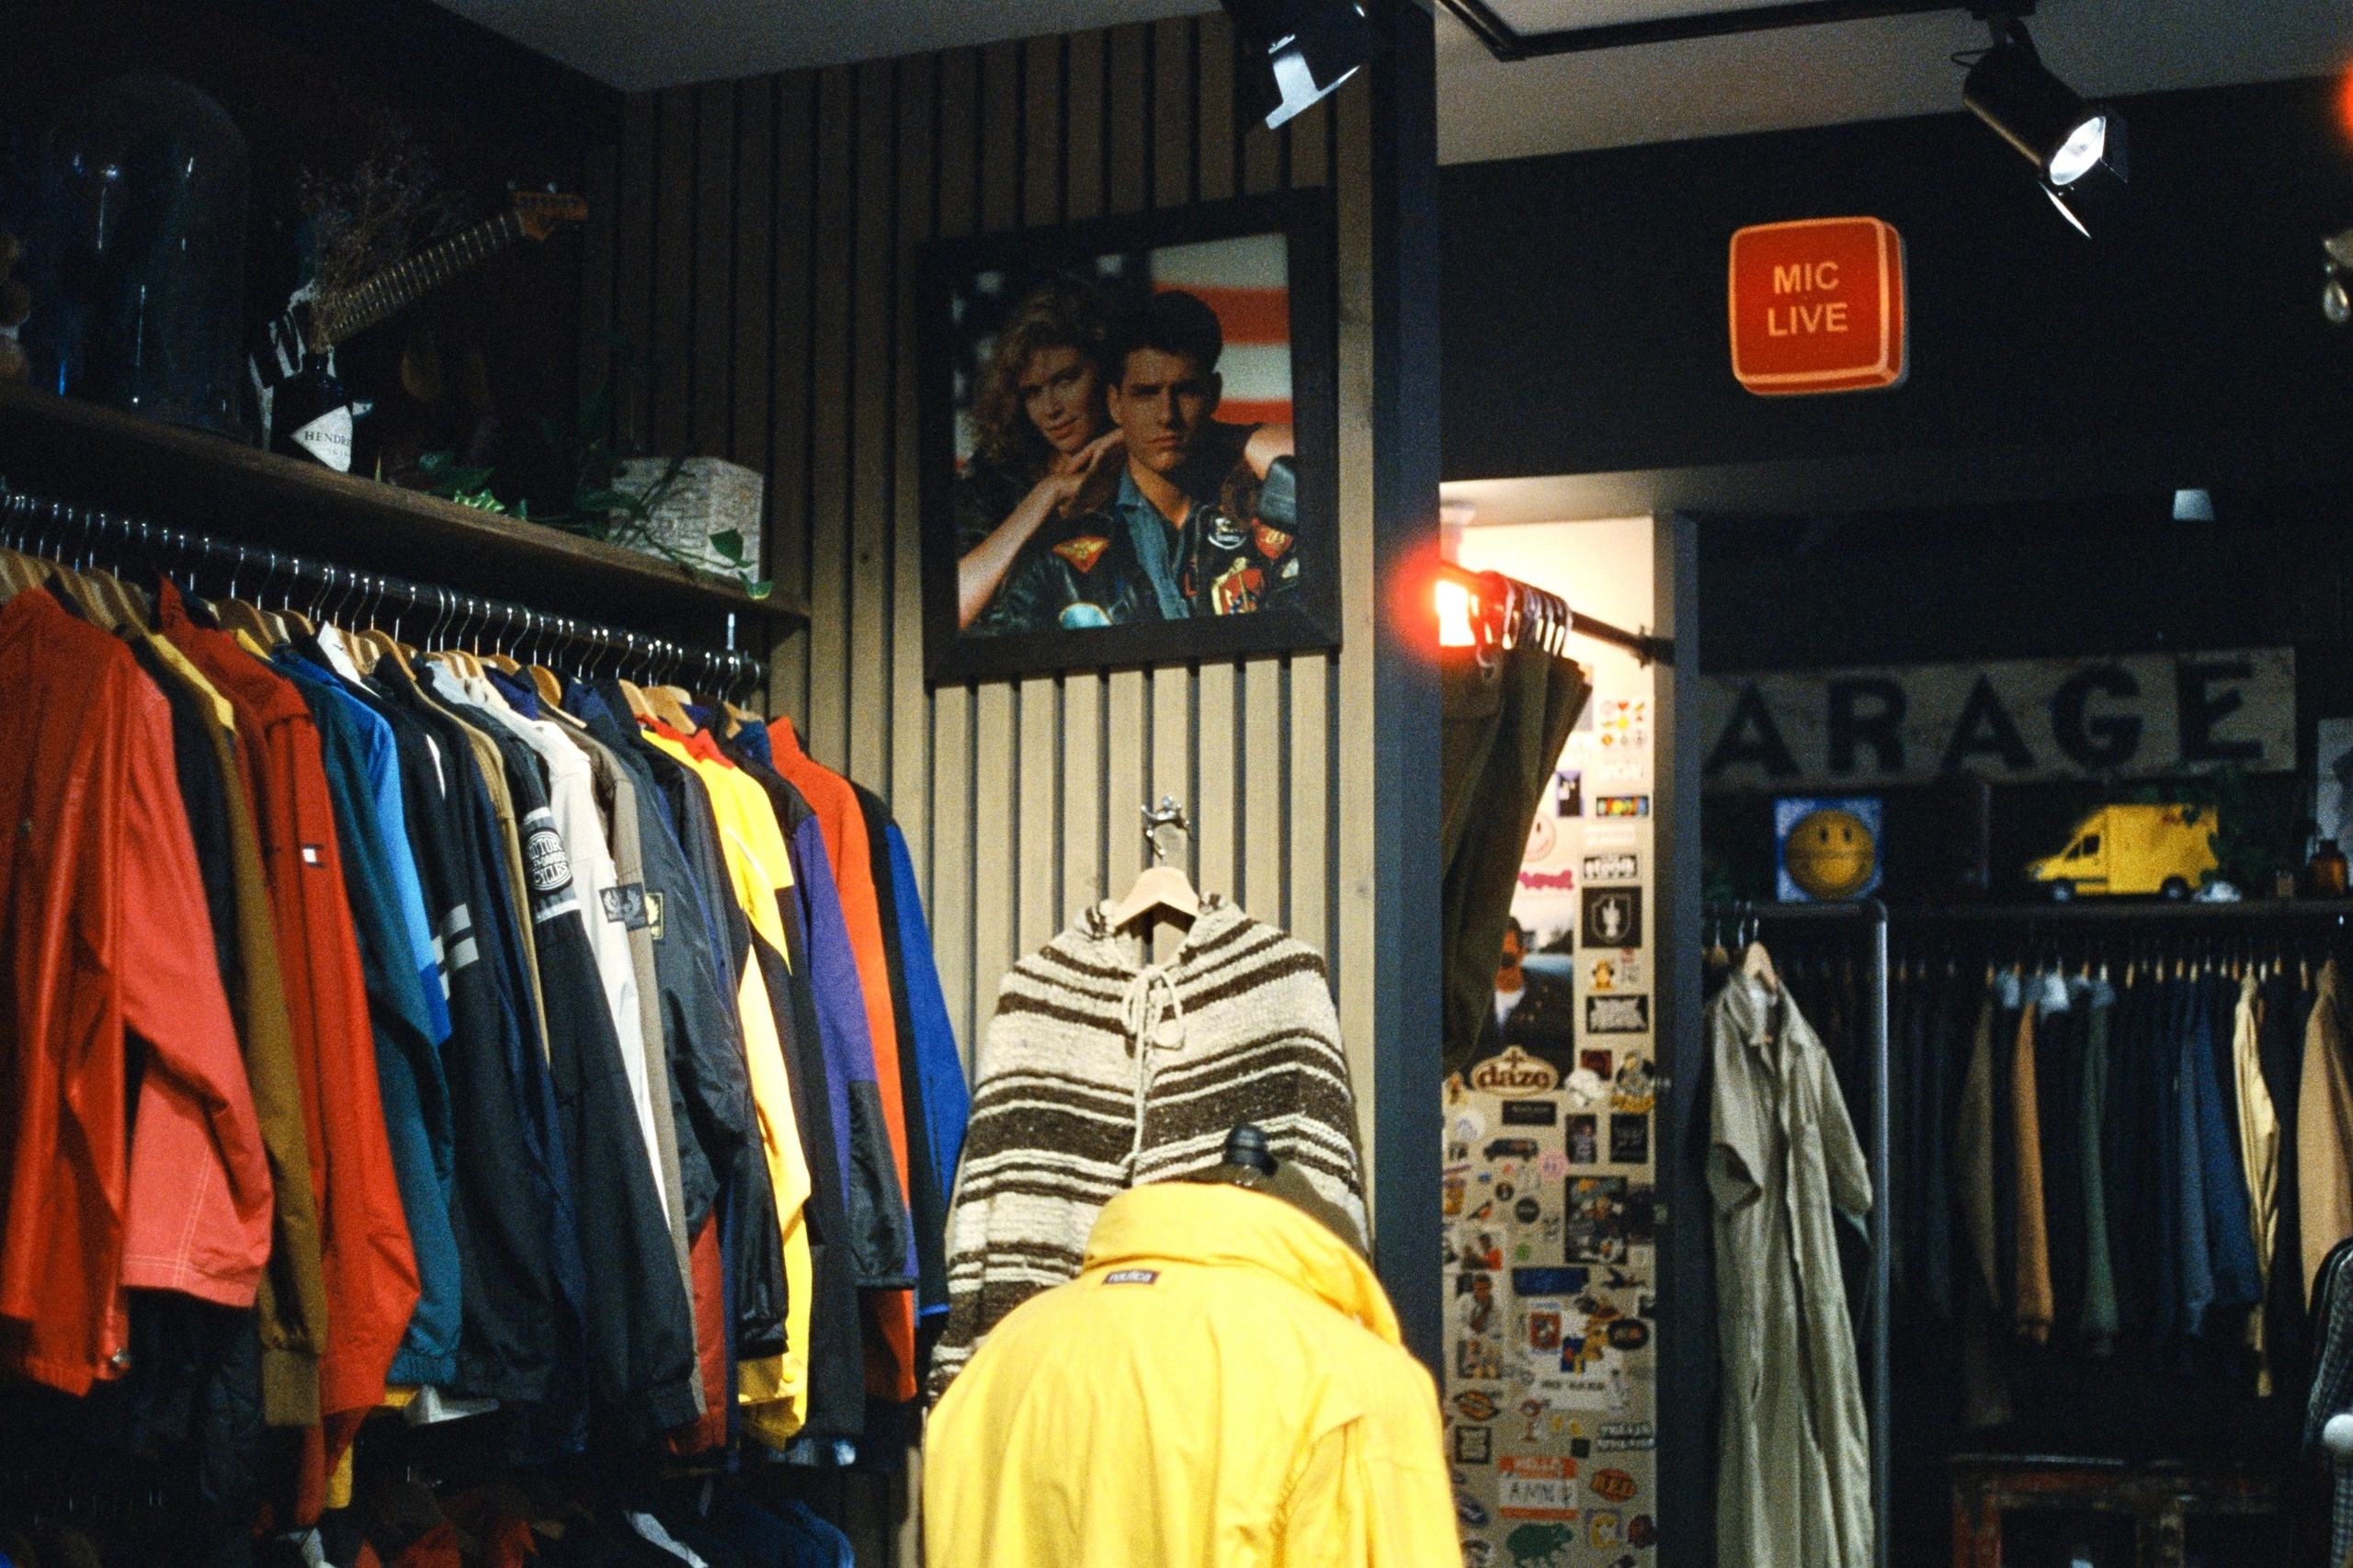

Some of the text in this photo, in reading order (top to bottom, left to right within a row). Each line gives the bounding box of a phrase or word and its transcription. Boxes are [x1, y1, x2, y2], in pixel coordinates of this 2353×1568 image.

[1773, 260, 1840, 295] MIC
[1767, 302, 1848, 336] LIVE
[533, 862, 568, 884] CYCLES
[1108, 1270, 1154, 1284] nautica
